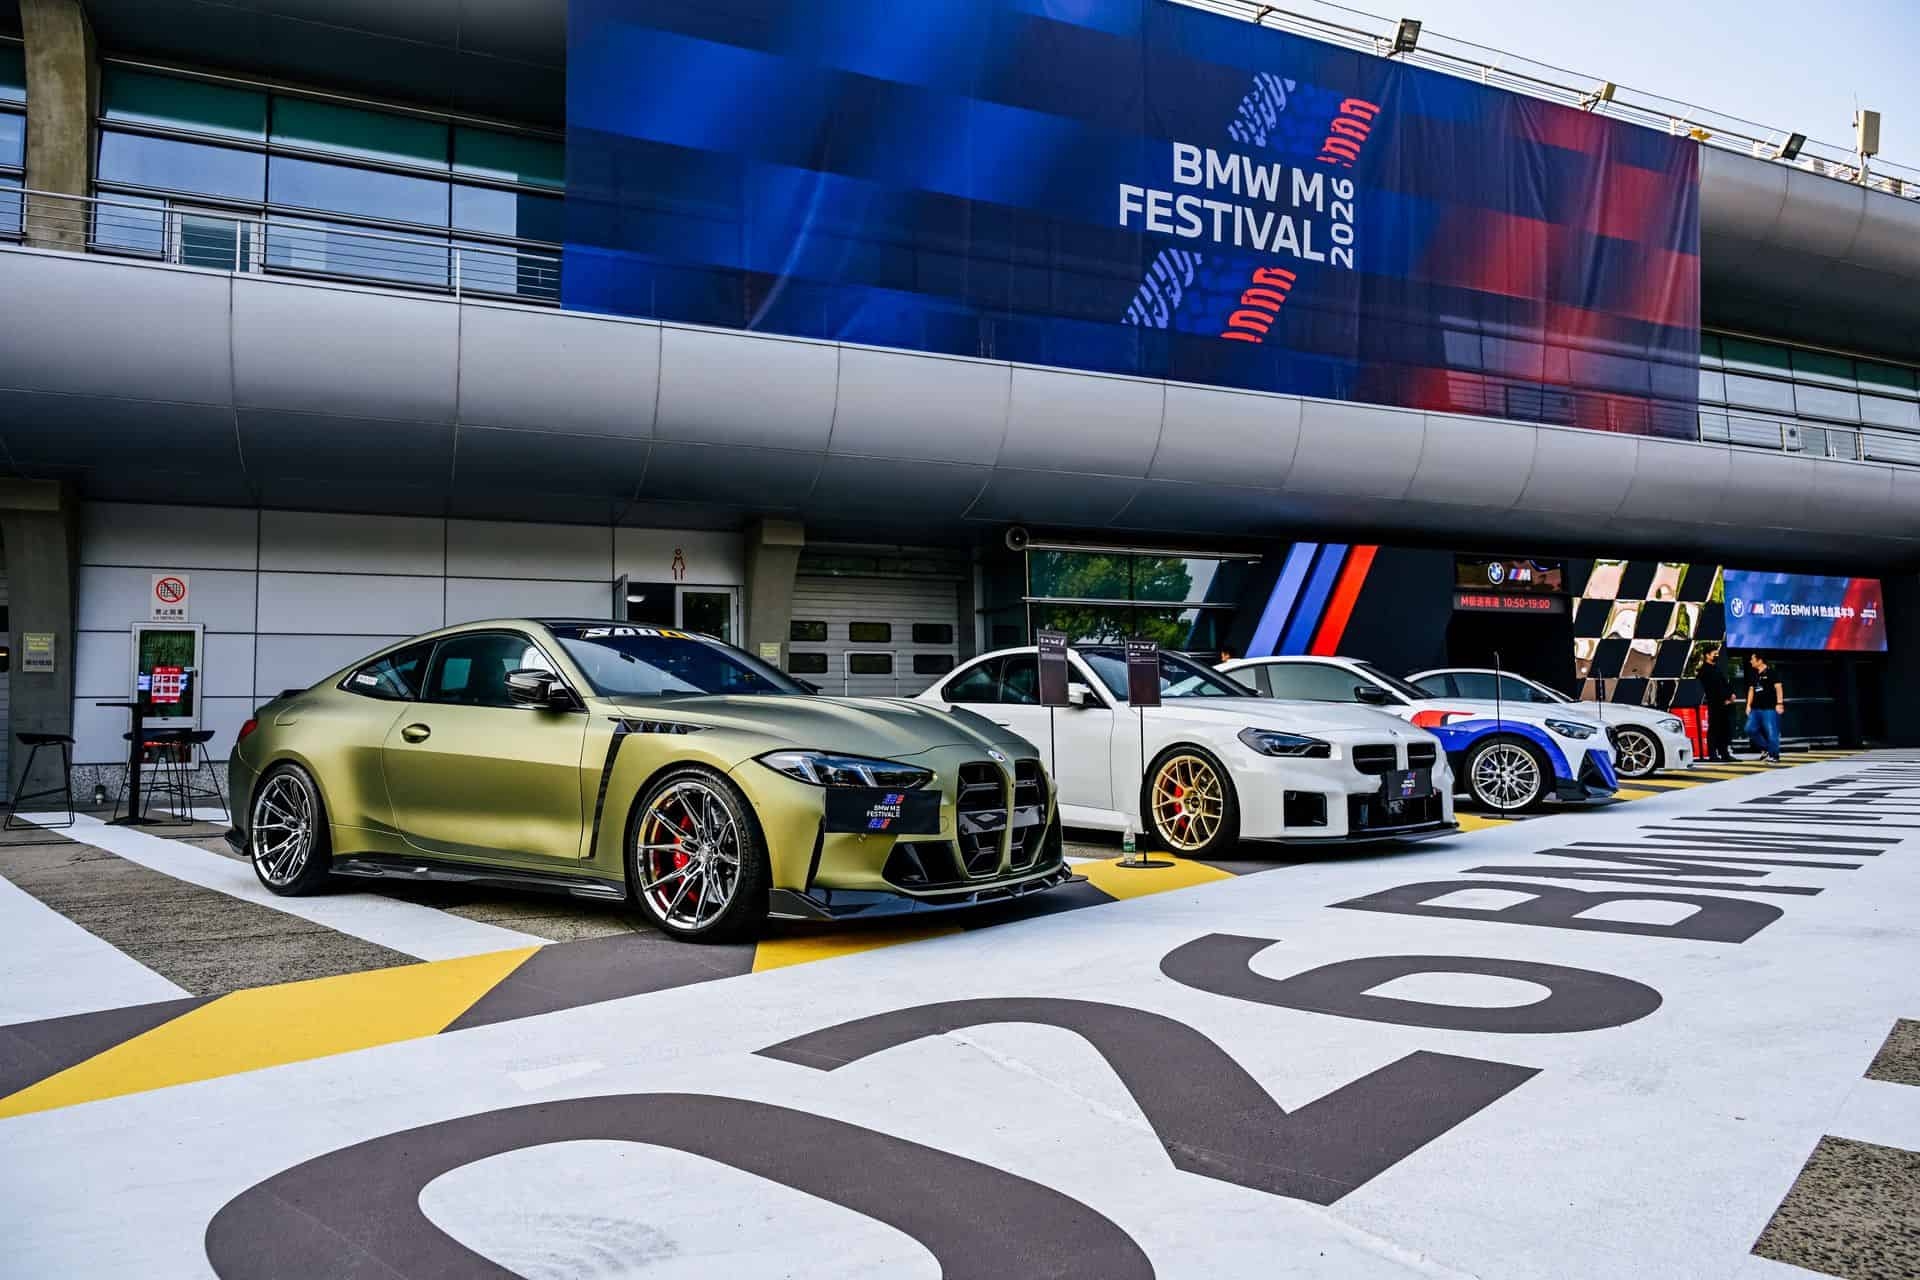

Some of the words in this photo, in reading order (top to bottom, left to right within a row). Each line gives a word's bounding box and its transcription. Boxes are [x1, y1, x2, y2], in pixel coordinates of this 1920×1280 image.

[1173, 142, 1281, 202] BMW
[1292, 167, 1323, 212] M
[1119, 183, 1325, 262] FESTIVAL
[1330, 177, 1354, 269] 2026
[1503, 598, 1551, 609] 10:50-19:00
[1770, 603, 1790, 616] 2026
[1791, 605, 1811, 617] BMW
[1812, 606, 1820, 617] M
[1325, 825, 1905, 944] BMW
